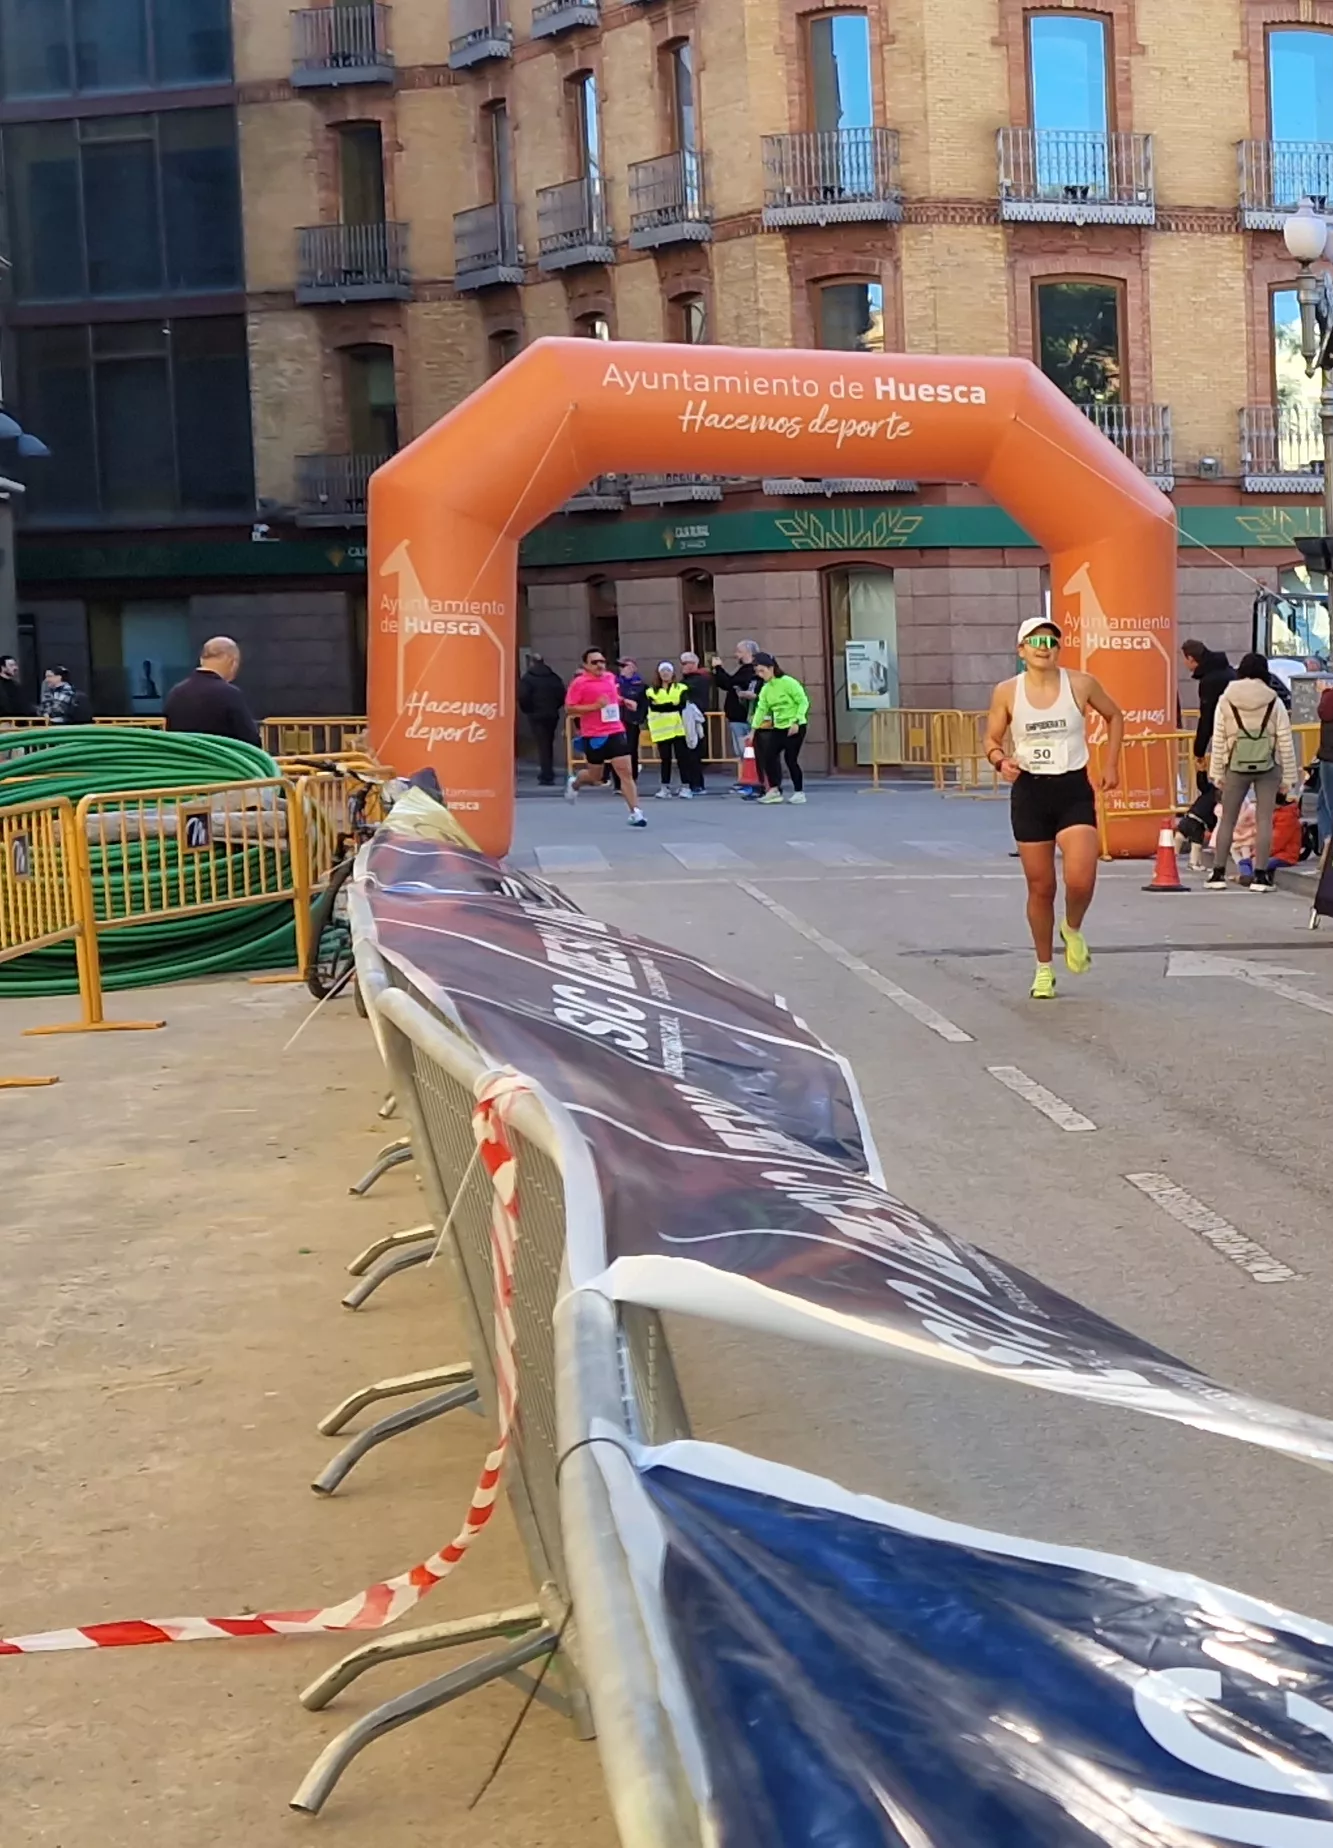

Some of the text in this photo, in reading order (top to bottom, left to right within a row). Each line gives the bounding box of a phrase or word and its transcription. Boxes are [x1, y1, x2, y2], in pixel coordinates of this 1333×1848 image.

[602, 363, 987, 404] Ayuntamiento de Huesca
[678, 400, 913, 449] Hacemos deporte
[380, 594, 505, 615] Ayuntamiento
[381, 616, 481, 635] de Huesca
[1064, 611, 1170, 631] Ayuntamiento
[1064, 633, 1152, 650] de Huesca
[405, 690, 498, 720] Hacemos
[405, 712, 487, 751] deporte
[1033, 749, 1051, 759] 50
[552, 984, 650, 1062] SIC
